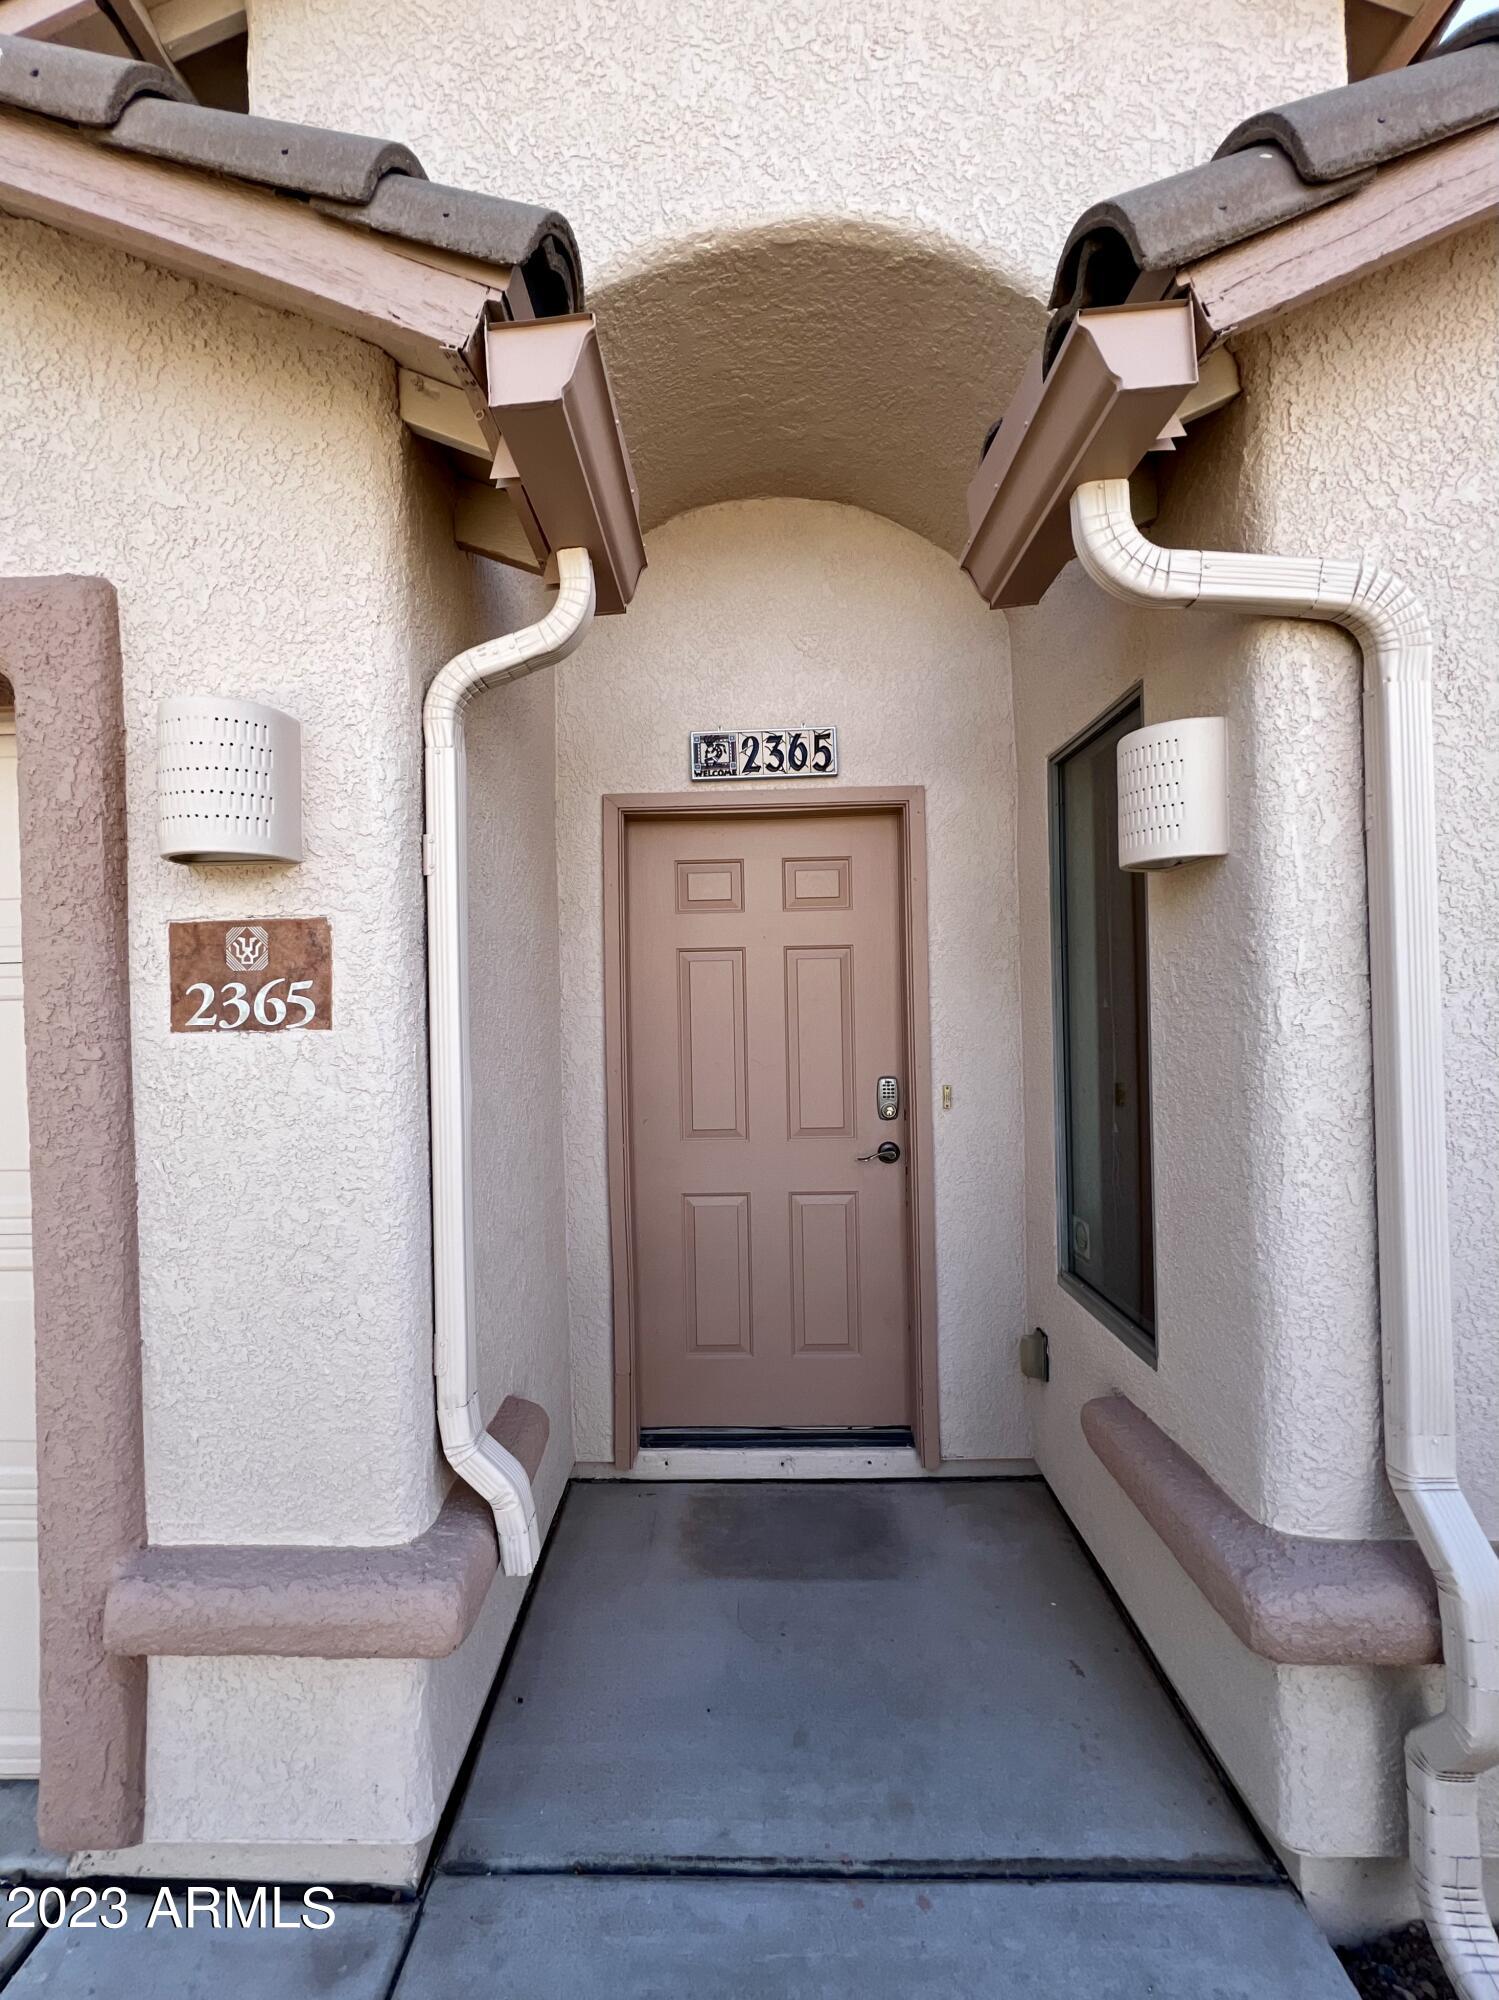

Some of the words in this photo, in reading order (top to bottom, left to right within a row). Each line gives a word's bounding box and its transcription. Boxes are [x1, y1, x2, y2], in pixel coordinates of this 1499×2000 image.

[694, 769, 737, 777] WELCOME
[741, 732, 832, 773] 2365
[185, 977, 316, 1029] 2365
